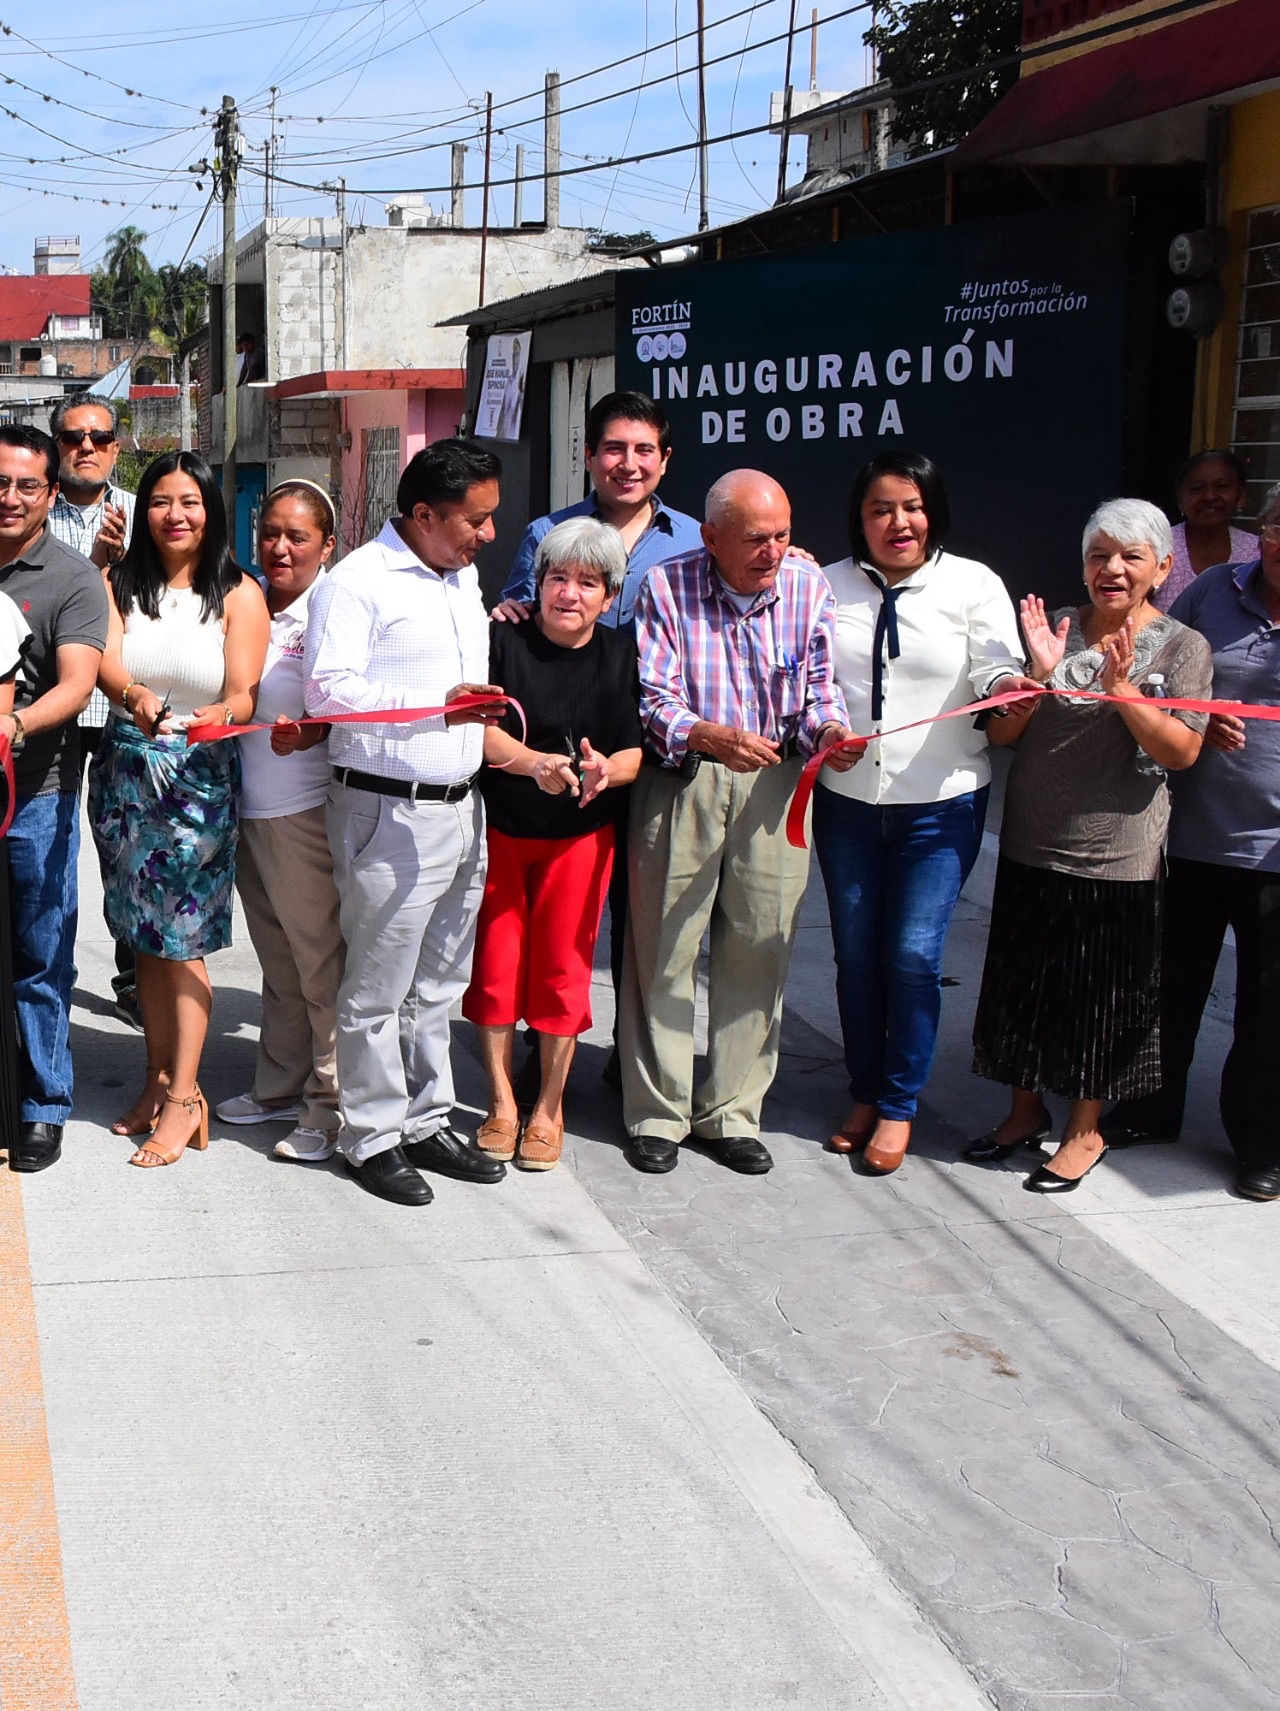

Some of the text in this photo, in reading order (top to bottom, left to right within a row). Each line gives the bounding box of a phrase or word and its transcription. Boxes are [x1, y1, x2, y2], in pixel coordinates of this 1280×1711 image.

[944, 291, 1088, 324] Transformación
[960, 279, 1062, 303] #Juntos por la
[631, 299, 692, 325] FORTÍN
[652, 328, 1014, 399] INAUGURACIÓN
[701, 399, 904, 444] DE OBRA
